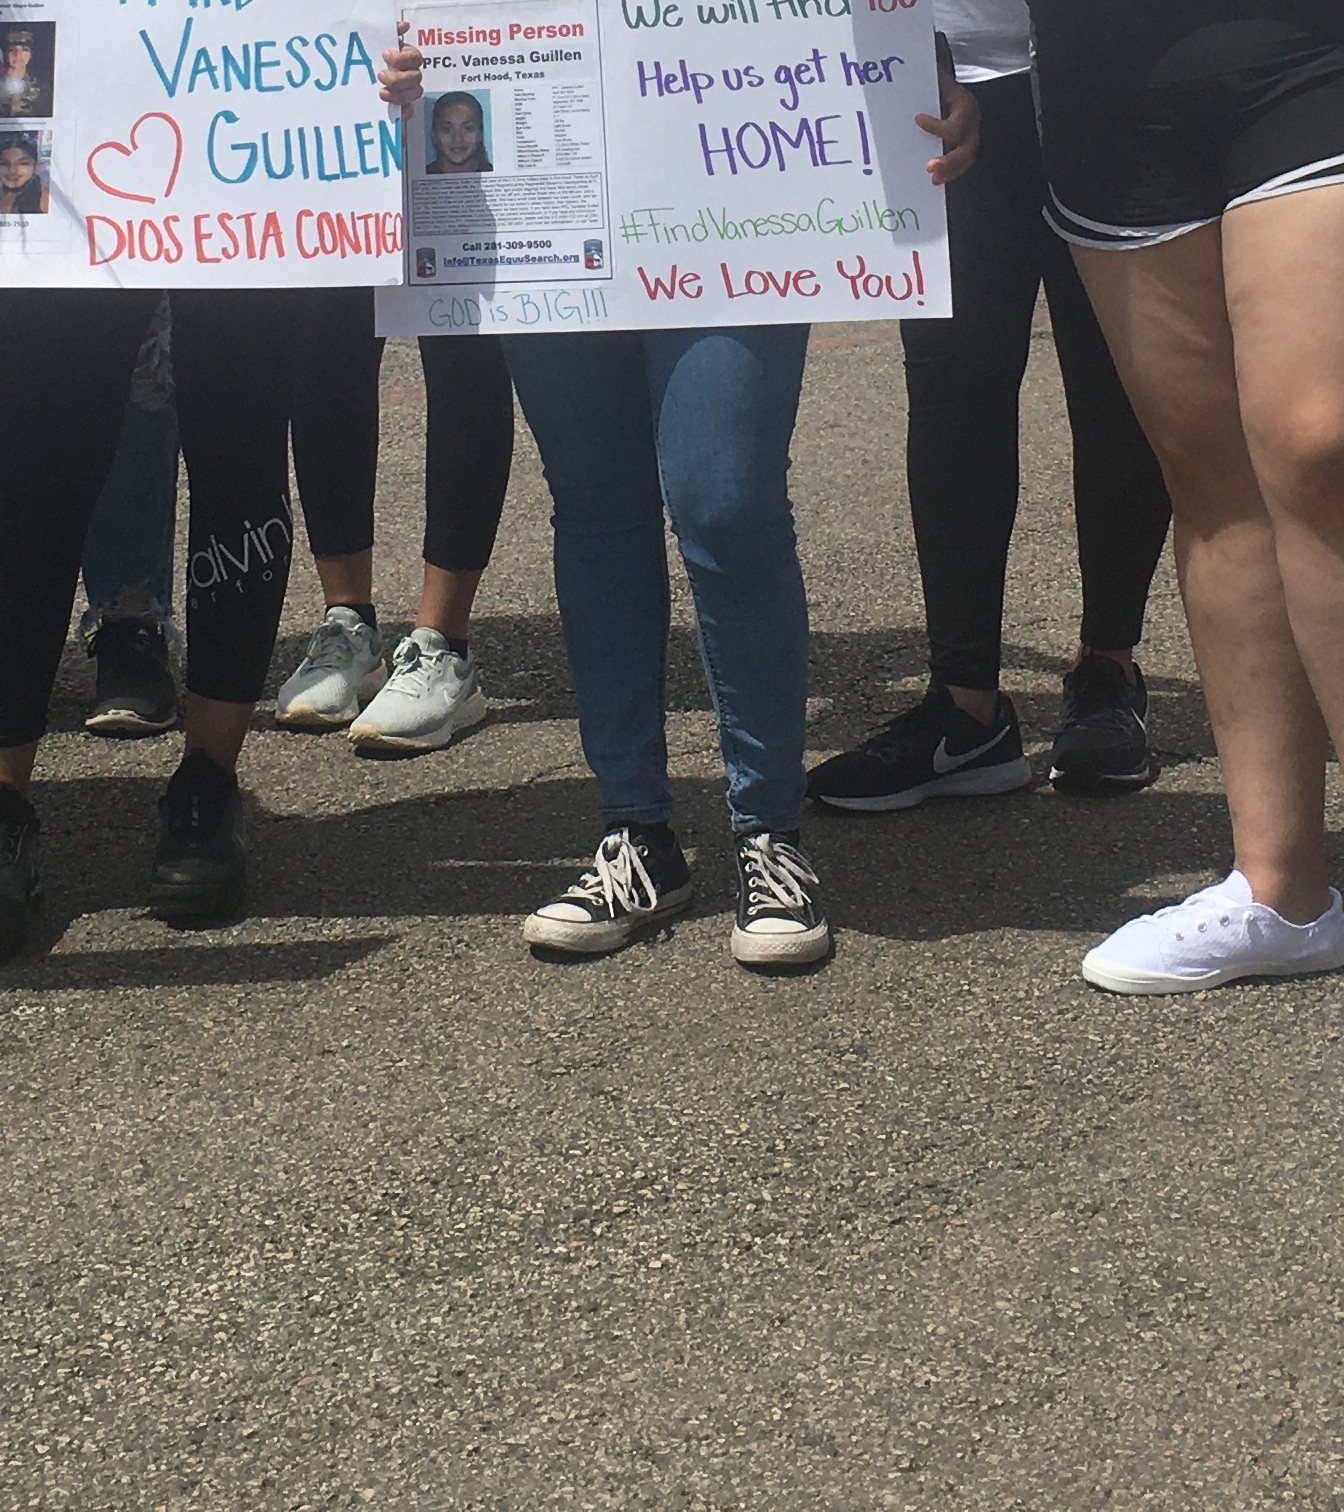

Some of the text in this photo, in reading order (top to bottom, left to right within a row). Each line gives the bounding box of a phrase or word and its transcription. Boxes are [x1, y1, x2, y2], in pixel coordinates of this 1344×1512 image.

[417, 22, 584, 46] Missing Person
[637, 48, 904, 111] Help us get her
[698, 111, 874, 176] HOME!
[86, 208, 403, 265] DIOS ESTA CONTIGO
[620, 197, 921, 244] #FindVanessaGuillen
[638, 250, 926, 305] We Love You!
[429, 294, 481, 326] GOD
